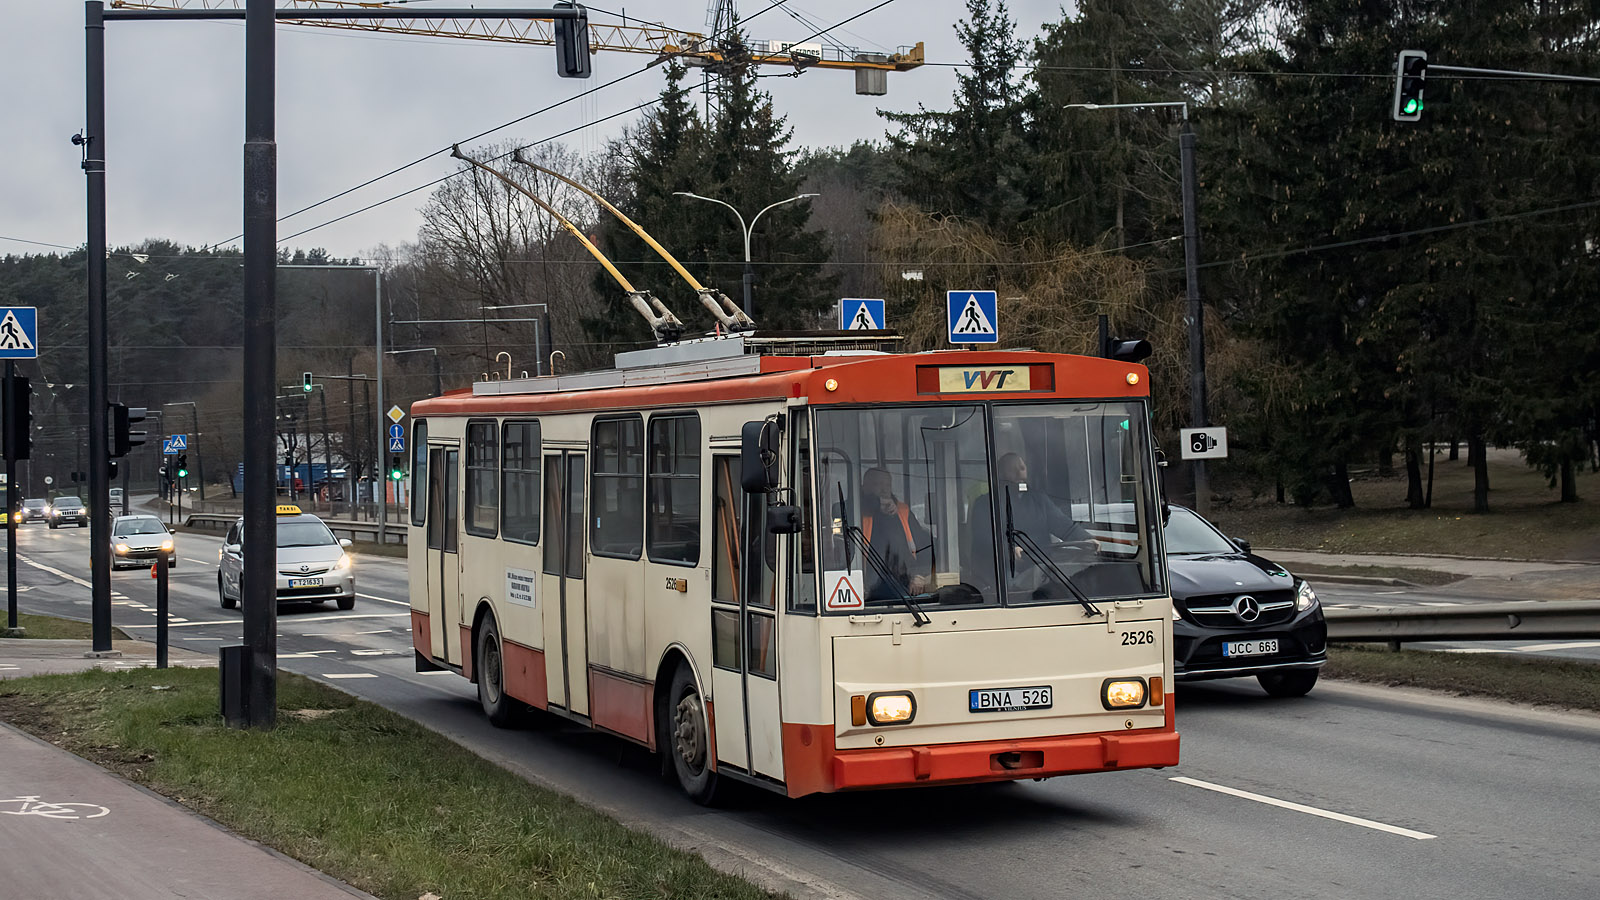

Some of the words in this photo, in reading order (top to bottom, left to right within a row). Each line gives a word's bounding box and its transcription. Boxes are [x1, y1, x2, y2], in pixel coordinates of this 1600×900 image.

[963, 369, 1015, 389] VVT
[837, 588, 851, 603] M
[1121, 630, 1154, 646] 2526
[1229, 642, 1252, 655] JCC
[1258, 640, 1277, 653] 663
[980, 691, 1012, 708] BNA
[1022, 689, 1049, 705] 526
